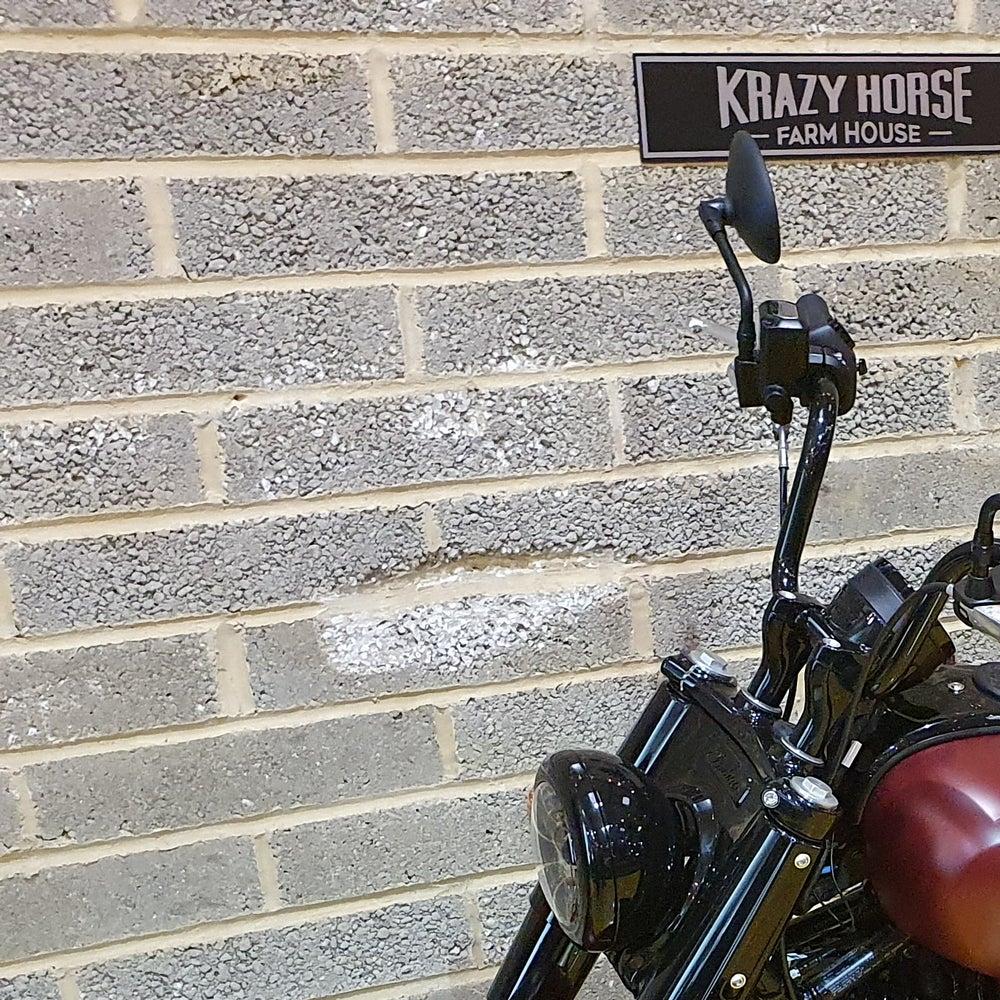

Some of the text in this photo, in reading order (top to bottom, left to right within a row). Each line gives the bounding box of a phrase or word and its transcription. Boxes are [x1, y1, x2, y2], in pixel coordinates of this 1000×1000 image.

[716, 66, 973, 128] KRAZY HORSE
[776, 121, 922, 146] FARM HOUSE
